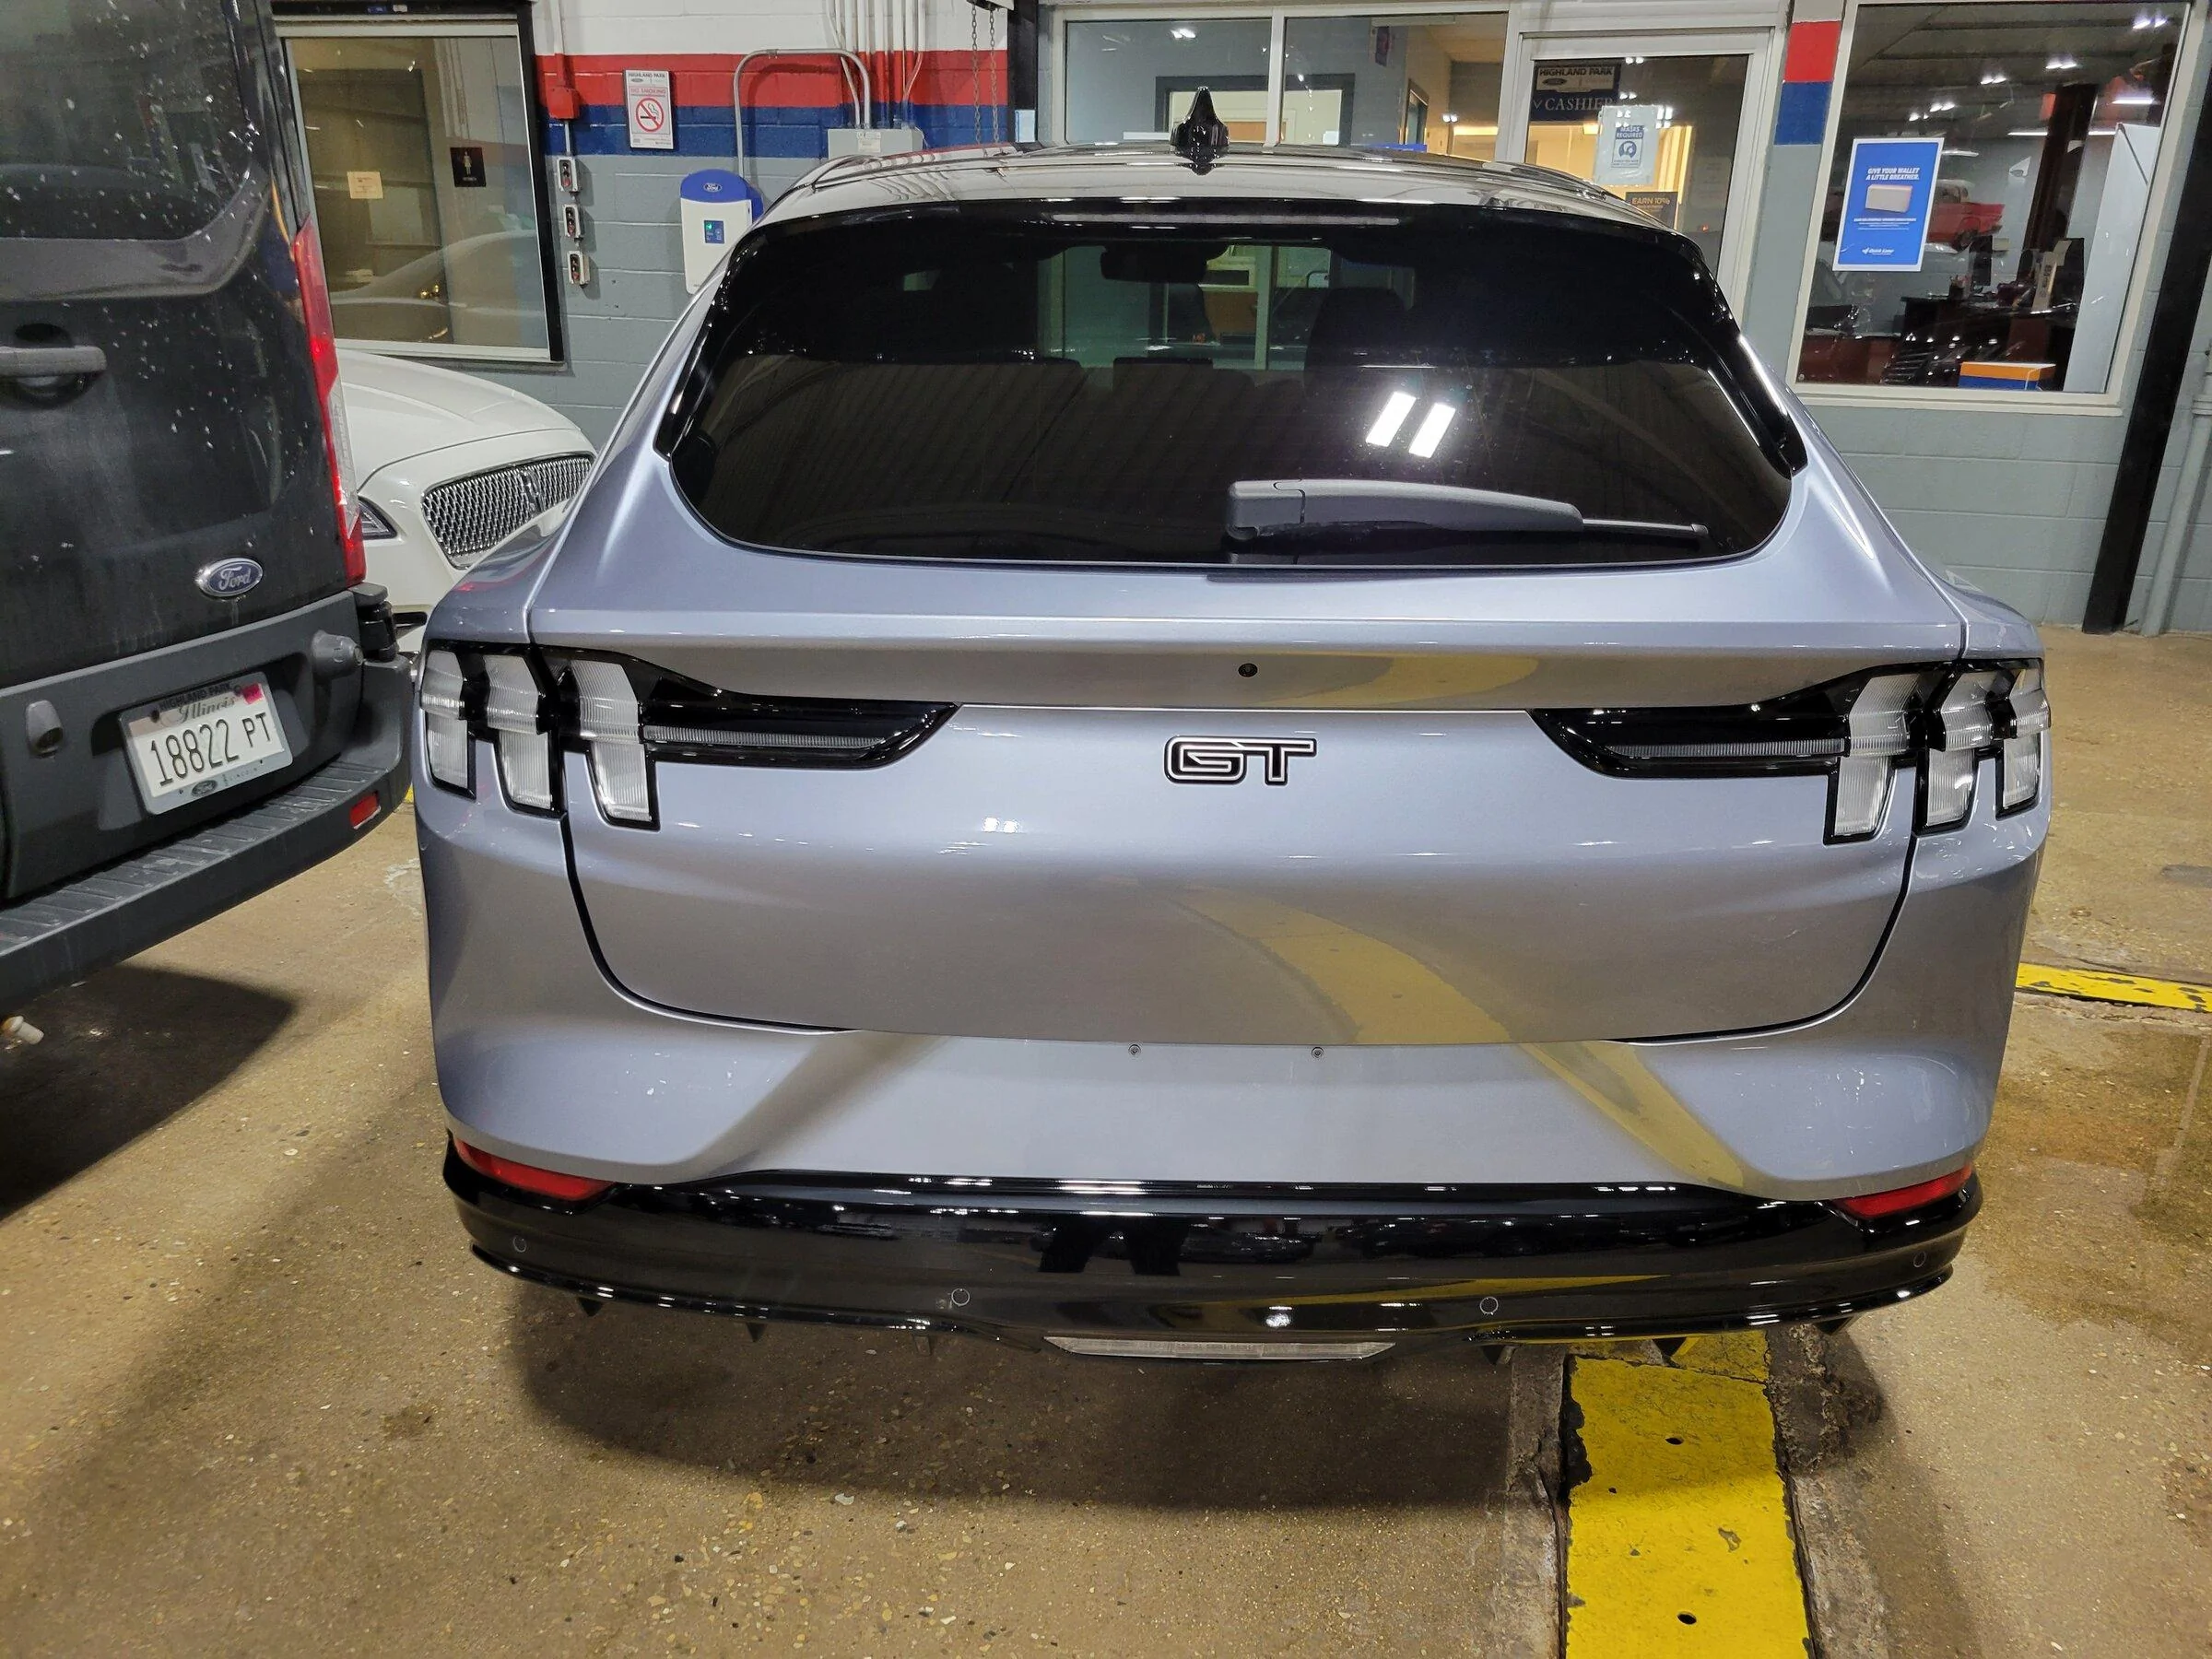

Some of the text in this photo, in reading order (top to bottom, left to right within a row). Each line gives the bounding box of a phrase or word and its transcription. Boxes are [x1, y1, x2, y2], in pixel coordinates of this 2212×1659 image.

[1589, 67, 1612, 76] PARK
[218, 565, 252, 591] Ford
[177, 697, 235, 724] Illinois
[150, 712, 271, 786] 18822 PT
[1164, 735, 1317, 785] GT
